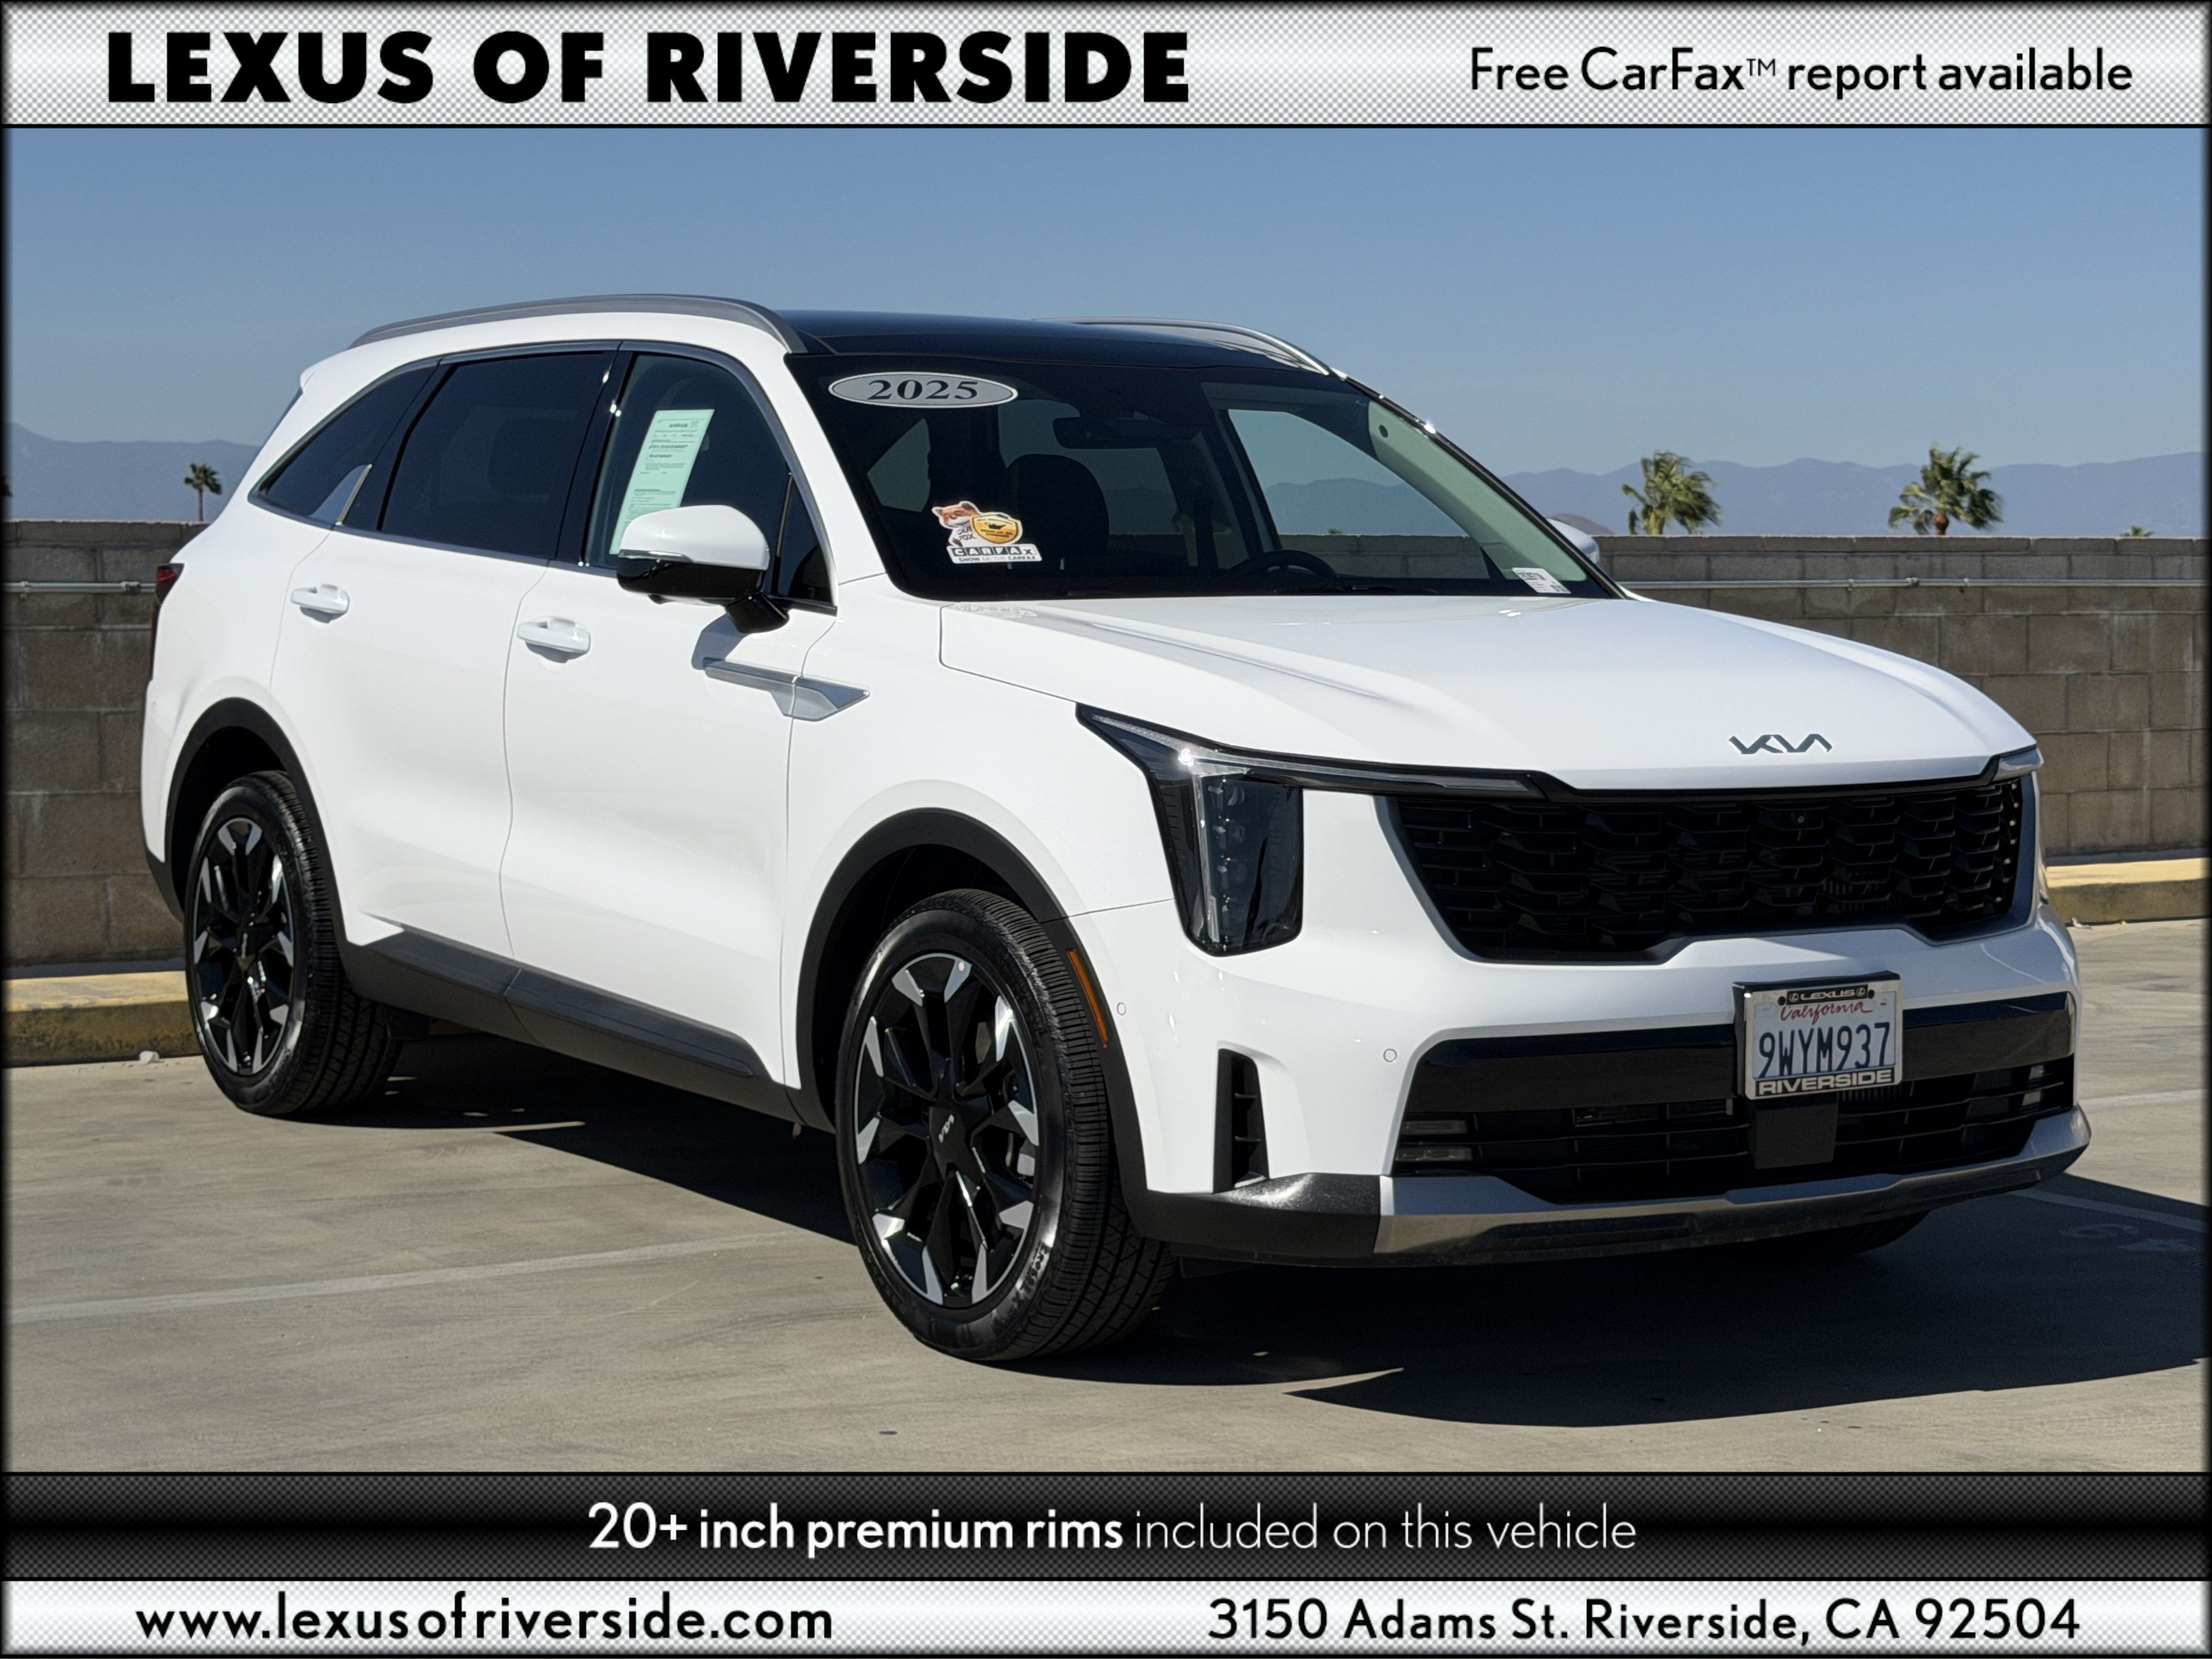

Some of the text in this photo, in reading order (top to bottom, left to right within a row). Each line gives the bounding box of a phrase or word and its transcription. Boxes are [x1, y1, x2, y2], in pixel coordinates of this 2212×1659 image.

[867, 379, 978, 400] 2025
[953, 546, 1034, 556] CARFAX
[1728, 733, 1833, 755] KIA
[1799, 989, 1855, 1001] LEXUS
[1780, 1001, 1873, 1025] California
[1758, 1022, 1891, 1079] 9WYM937
[1758, 1069, 1892, 1096] RIVERSIDE
